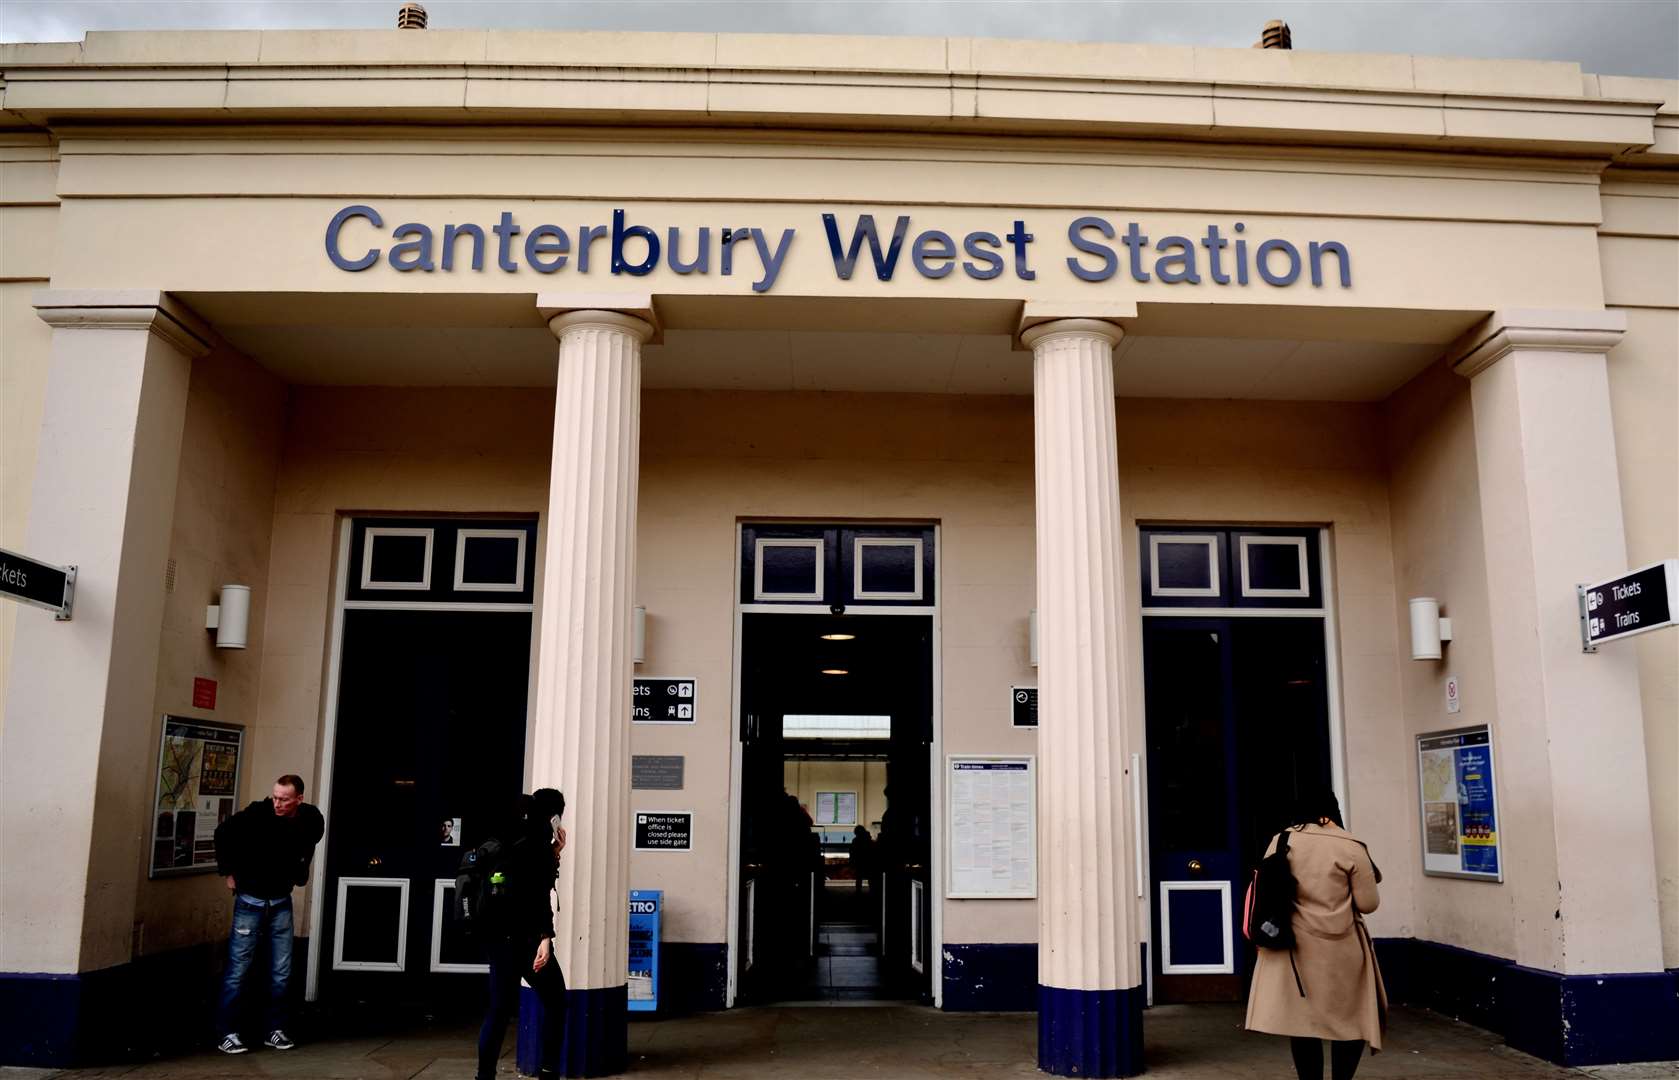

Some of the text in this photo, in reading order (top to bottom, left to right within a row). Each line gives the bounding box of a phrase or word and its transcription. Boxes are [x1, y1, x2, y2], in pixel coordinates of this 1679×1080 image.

[324, 205, 1353, 293] Canterbury West Station
[1612, 582, 1641, 601] Tickets
[1615, 611, 1640, 628] Trains
[647, 816, 685, 824] When ticket
[668, 832, 688, 840] please
